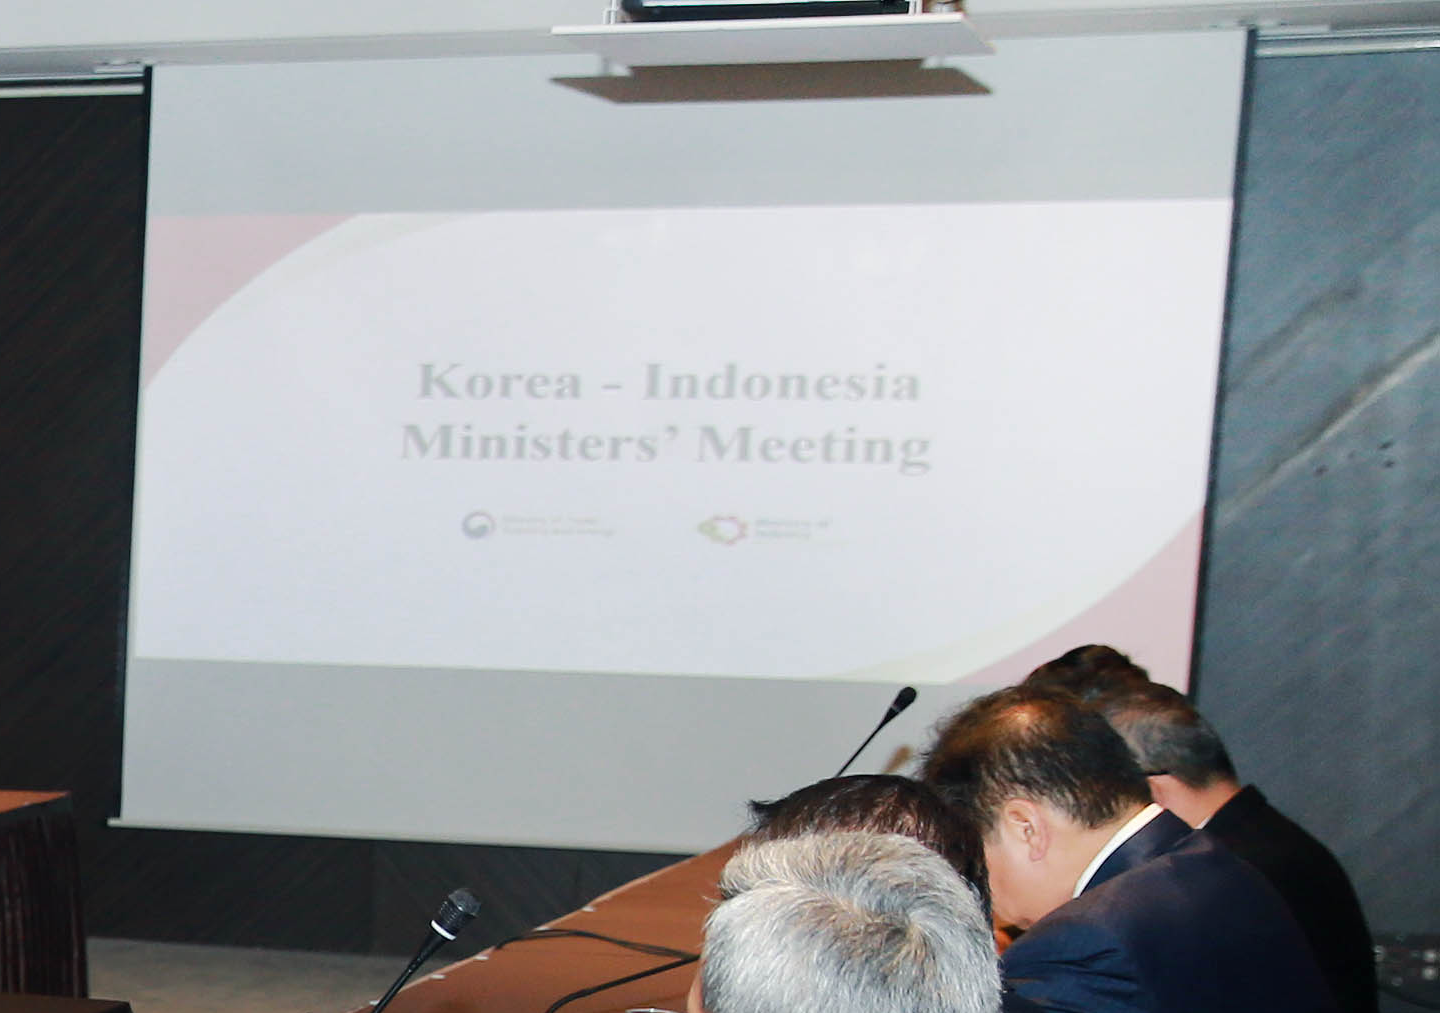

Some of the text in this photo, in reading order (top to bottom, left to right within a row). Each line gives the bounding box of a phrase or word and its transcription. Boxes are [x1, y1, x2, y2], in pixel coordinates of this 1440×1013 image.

[418, 362, 583, 401] Korea
[644, 362, 922, 402] Indonesia
[697, 425, 933, 476] Meeting
